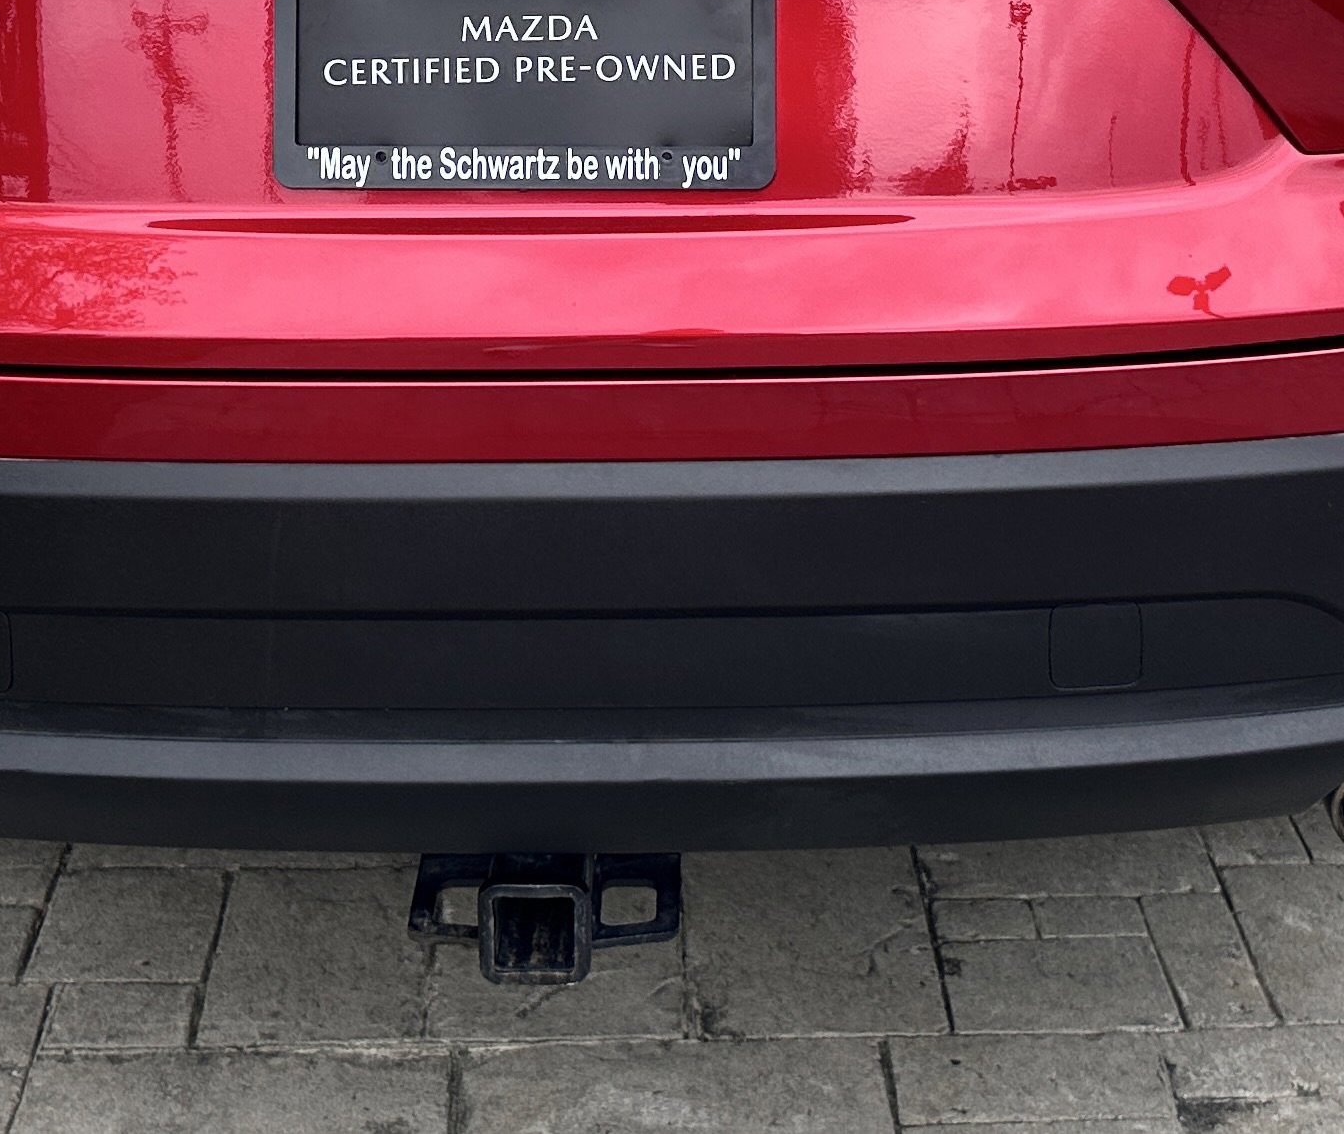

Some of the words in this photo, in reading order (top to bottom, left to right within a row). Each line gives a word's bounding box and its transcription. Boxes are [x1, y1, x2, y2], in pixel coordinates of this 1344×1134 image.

[460, 14, 599, 43] MAZDA
[323, 57, 500, 86] CERTIFIED
[515, 54, 737, 84] PRE-OWNED
[306, 146, 371, 188] "May
[390, 146, 433, 180] the
[438, 146, 561, 181] Schwartz
[565, 147, 599, 181] be
[605, 147, 660, 181] with
[681, 147, 741, 189] you"
